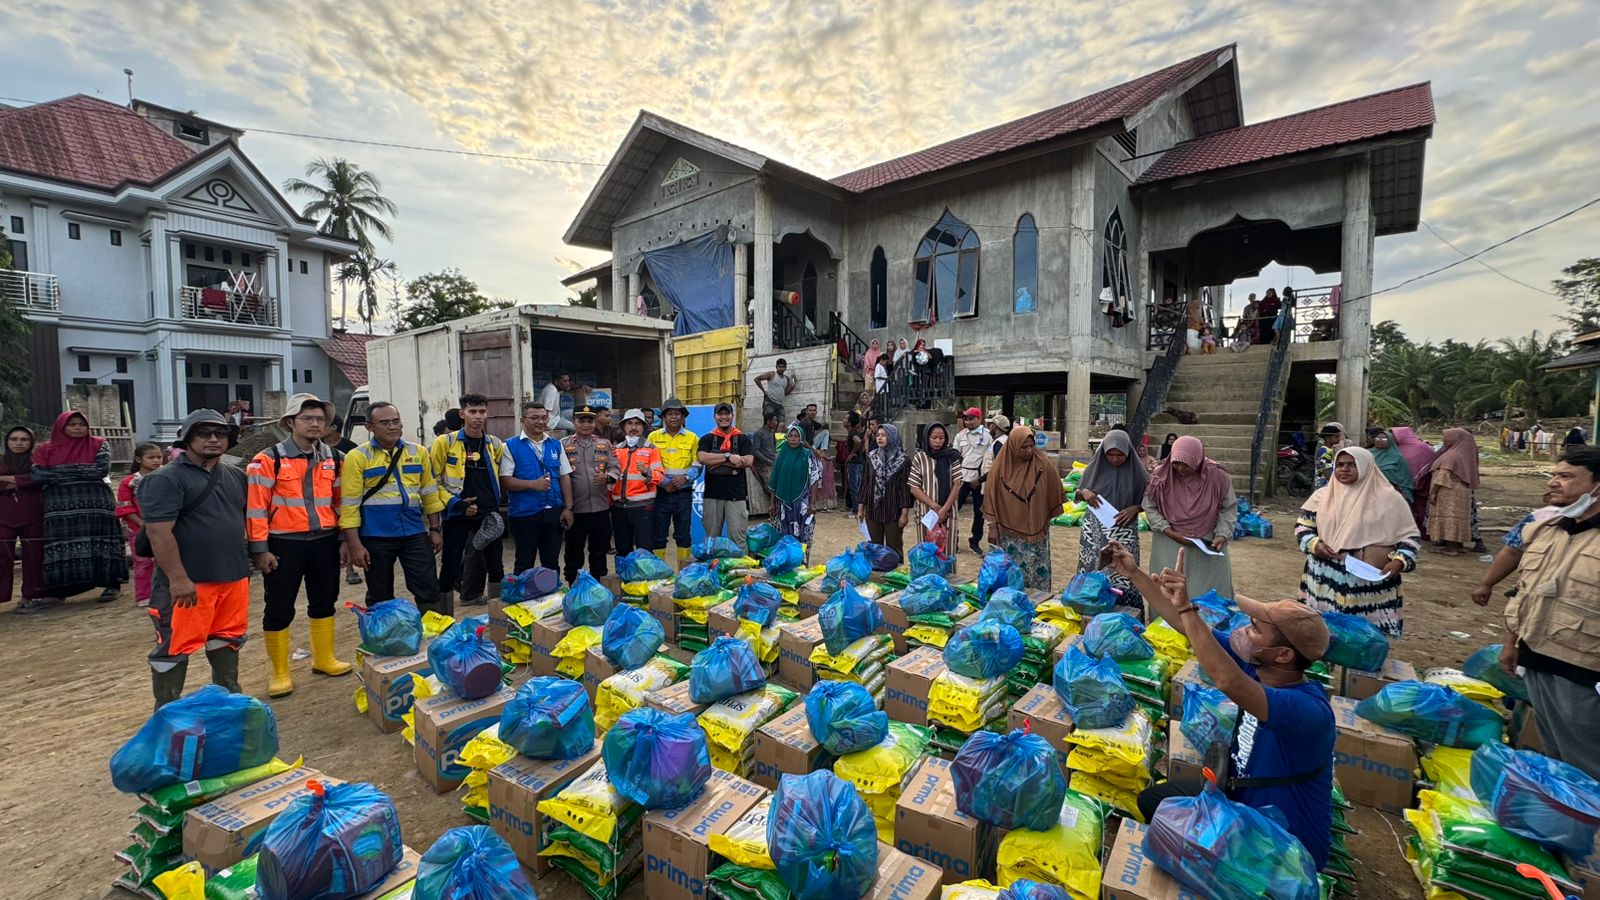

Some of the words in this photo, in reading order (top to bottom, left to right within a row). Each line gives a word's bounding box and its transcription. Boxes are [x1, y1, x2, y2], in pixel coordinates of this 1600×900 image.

[799, 602, 820, 613] prim
[781, 648, 811, 668] prima
[887, 688, 928, 711] prima
[757, 761, 783, 780] pri
[1333, 750, 1411, 782] prima
[239, 771, 305, 799] prima
[911, 774, 940, 805] prima
[490, 803, 533, 837] prima
[692, 800, 735, 836] prima
[898, 838, 970, 876] prima
[1120, 840, 1149, 887] prima
[647, 853, 704, 896] prima
[886, 865, 926, 900] rima
